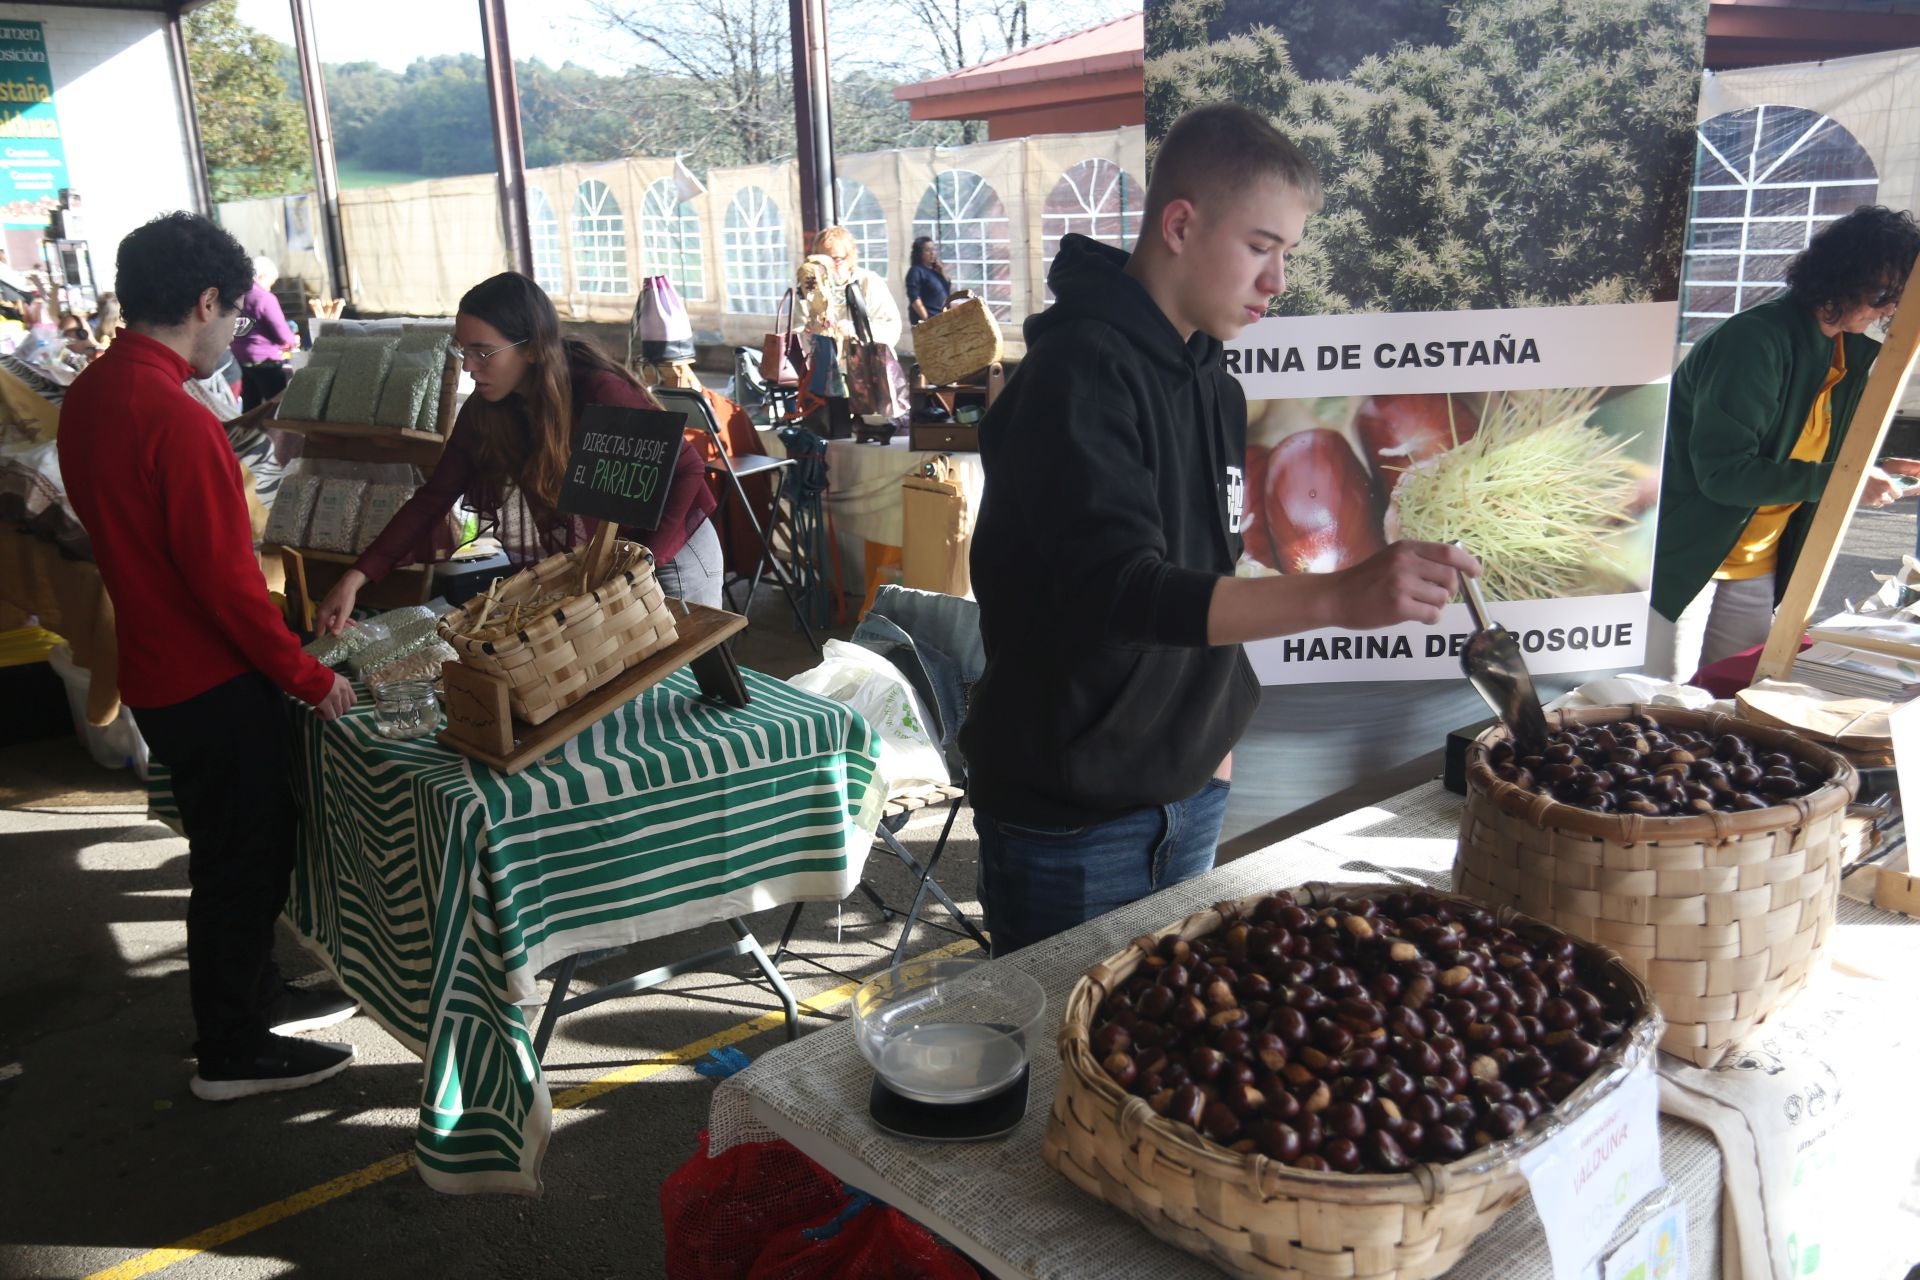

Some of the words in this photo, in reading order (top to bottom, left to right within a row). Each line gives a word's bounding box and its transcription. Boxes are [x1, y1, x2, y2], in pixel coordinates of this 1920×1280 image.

[0, 76, 51, 103] staña
[1223, 347, 1305, 374] RINA
[1317, 344, 1361, 371] DE
[1374, 334, 1541, 369] CASTAÑA
[582, 432, 634, 457] DIRECTAS
[634, 438, 668, 464] DESDE
[573, 465, 586, 484] EL
[1283, 636, 1413, 663] HARINA
[1425, 633, 1468, 658] DE
[1507, 623, 1633, 653] OSQUE
